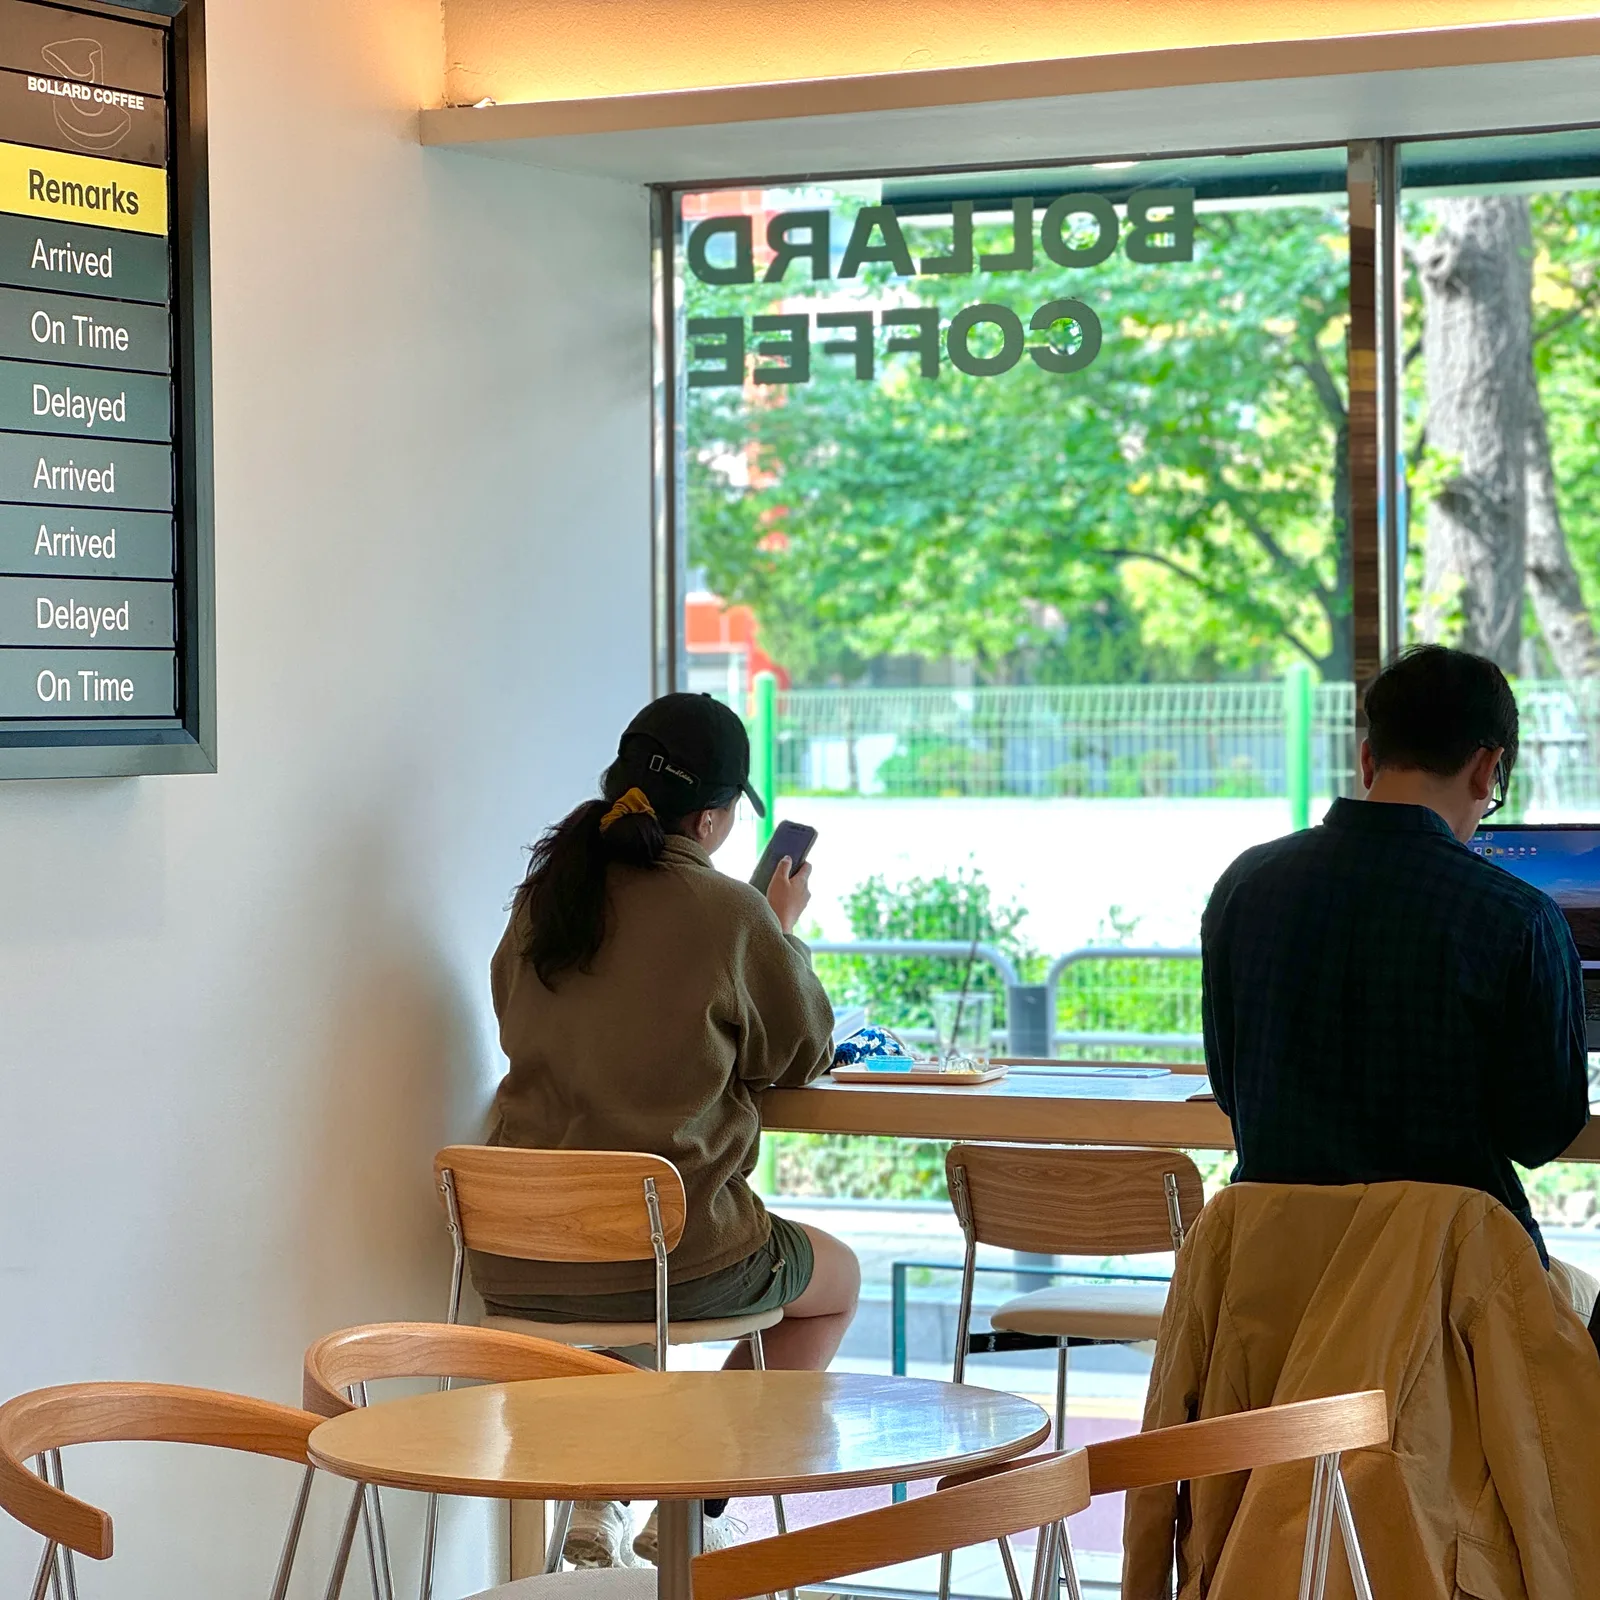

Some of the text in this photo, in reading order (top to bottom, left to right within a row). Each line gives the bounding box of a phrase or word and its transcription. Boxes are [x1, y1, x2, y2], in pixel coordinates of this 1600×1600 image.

[27, 76, 145, 110] BOLLARD COFFEE
[28, 168, 139, 216] Remarks
[31, 238, 112, 278] Arrived
[31, 310, 129, 351] On Time
[33, 383, 126, 428] Delayed
[33, 457, 115, 493] Arrived
[34, 524, 116, 559] Arrived
[36, 597, 129, 639] Delayed
[36, 669, 134, 702] On Time
